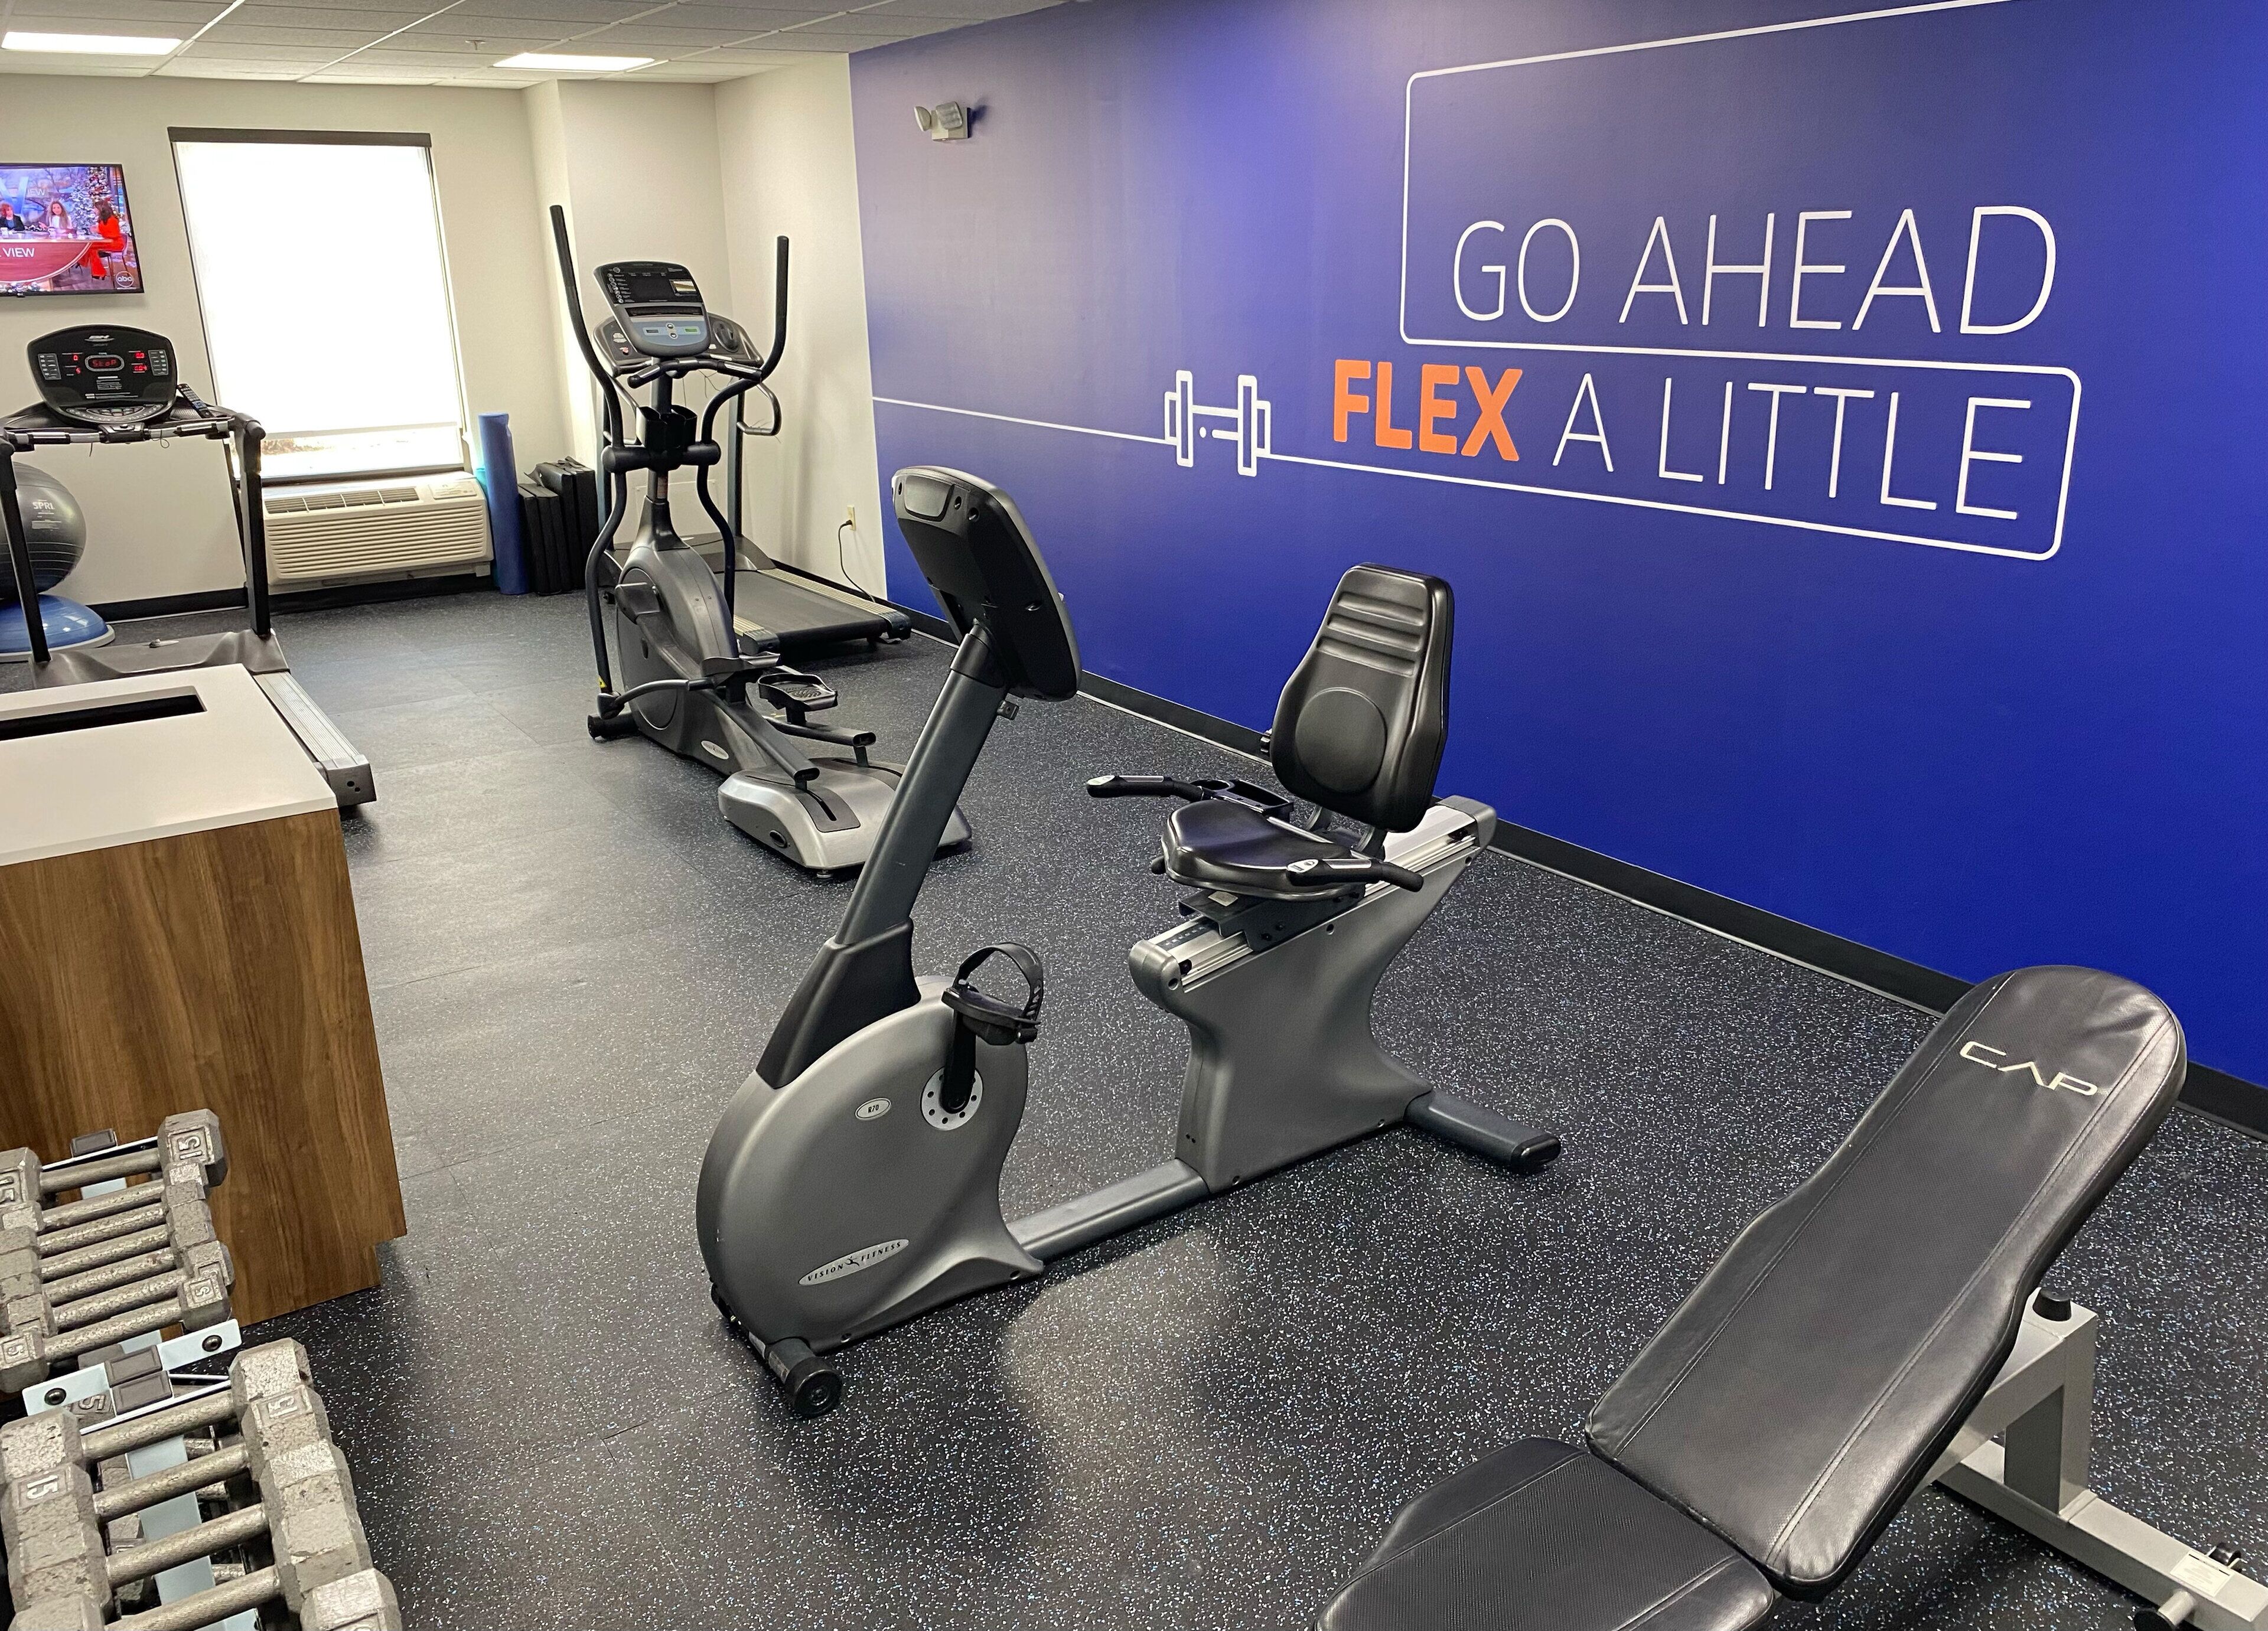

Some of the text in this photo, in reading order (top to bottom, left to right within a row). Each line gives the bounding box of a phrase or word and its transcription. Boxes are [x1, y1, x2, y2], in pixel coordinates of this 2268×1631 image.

[2, 247, 35, 257] VIEW
[1454, 205, 2056, 335] GO AHEAD
[1333, 360, 2032, 520] FLEX A LITTLE
[1960, 1041, 2098, 1096] CAP
[868, 1104, 879, 1113] R70
[178, 1135, 203, 1160] 15
[807, 1241, 901, 1281] VISION FITNESS
[268, 1396, 298, 1418] 15
[27, 1475, 58, 1499] 15
